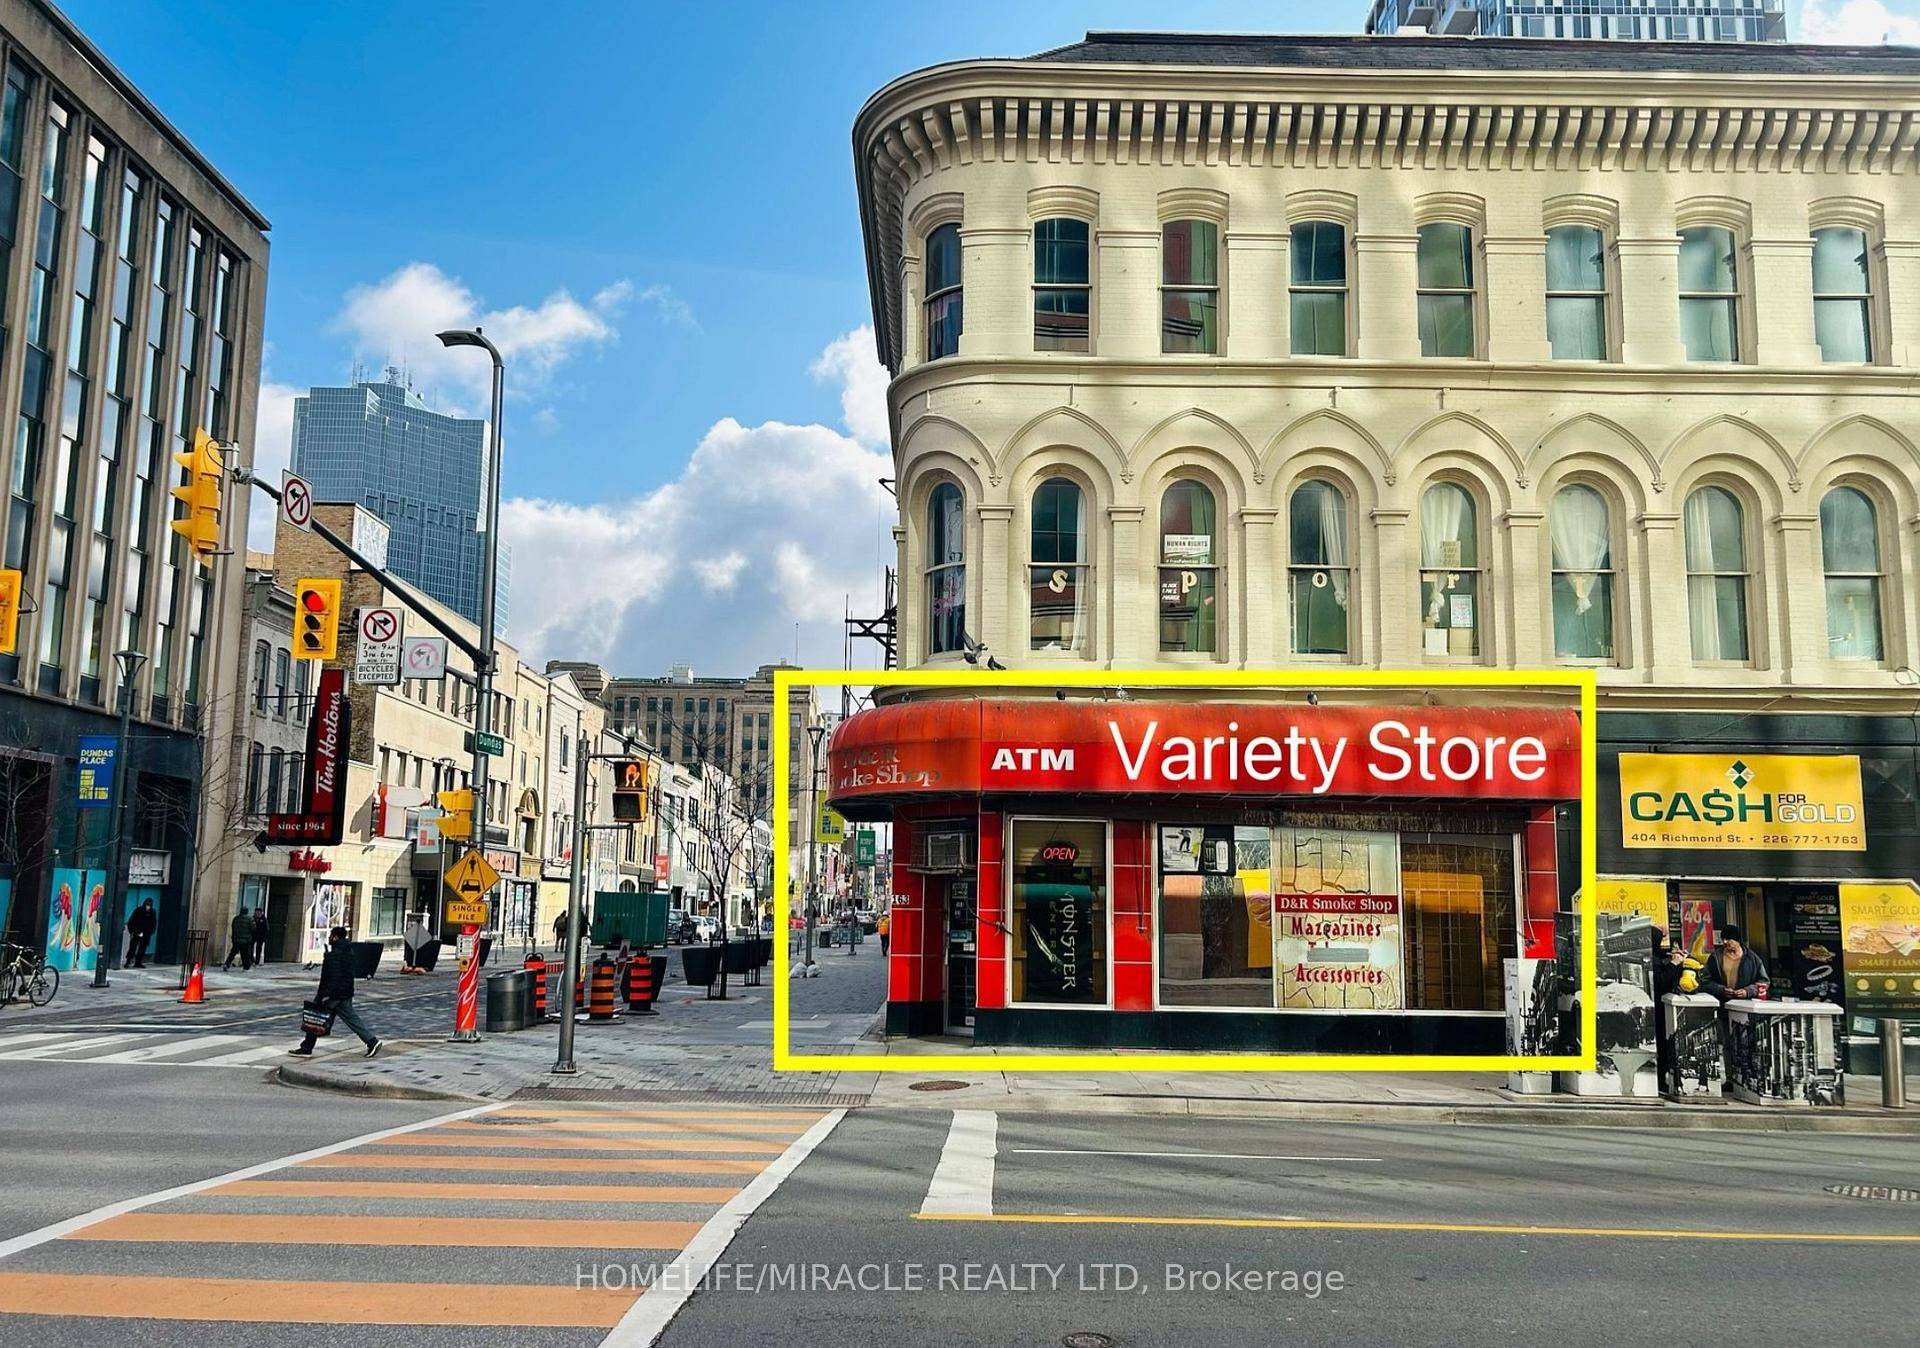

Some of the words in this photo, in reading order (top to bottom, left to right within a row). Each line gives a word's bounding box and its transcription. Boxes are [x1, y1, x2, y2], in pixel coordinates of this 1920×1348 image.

[358, 665, 394, 673] BICYCLES
[358, 673, 394, 681] EXCEPTED
[317, 689, 341, 759] Hortons
[479, 734, 503, 750] Dundas
[80, 749, 114, 758] DUNDAS
[991, 748, 1074, 771] ATM
[1109, 721, 1347, 794] Variety
[1368, 721, 1546, 782] Store
[79, 757, 107, 765] PLACE
[316, 758, 334, 794] Tim
[1629, 788, 1773, 826] CA$H
[1777, 793, 1806, 804] FOR
[1777, 803, 1857, 824] GOLD
[277, 822, 301, 831] since
[303, 821, 326, 831] 1964
[1631, 833, 1657, 842] 404
[1661, 833, 1723, 843] Richmond
[1727, 834, 1745, 844] St.
[1762, 834, 1859, 845] 226-777-1763
[1042, 847, 1076, 861] OPEN
[452, 904, 482, 912] SINGLE
[1280, 897, 1308, 909] D&R
[1312, 897, 1356, 910] Smoke
[1360, 898, 1393, 913] Shop
[1596, 900, 1624, 911] MART
[1627, 901, 1658, 912] GOLD
[1851, 905, 1887, 915] SMART
[1889, 905, 1920, 915] GOLD
[457, 913, 475, 921] FILE
[1684, 911, 1712, 924] 404
[1857, 958, 1889, 967] SMART
[1892, 958, 1920, 967] LOAN
[1295, 963, 1383, 984] Accessories
